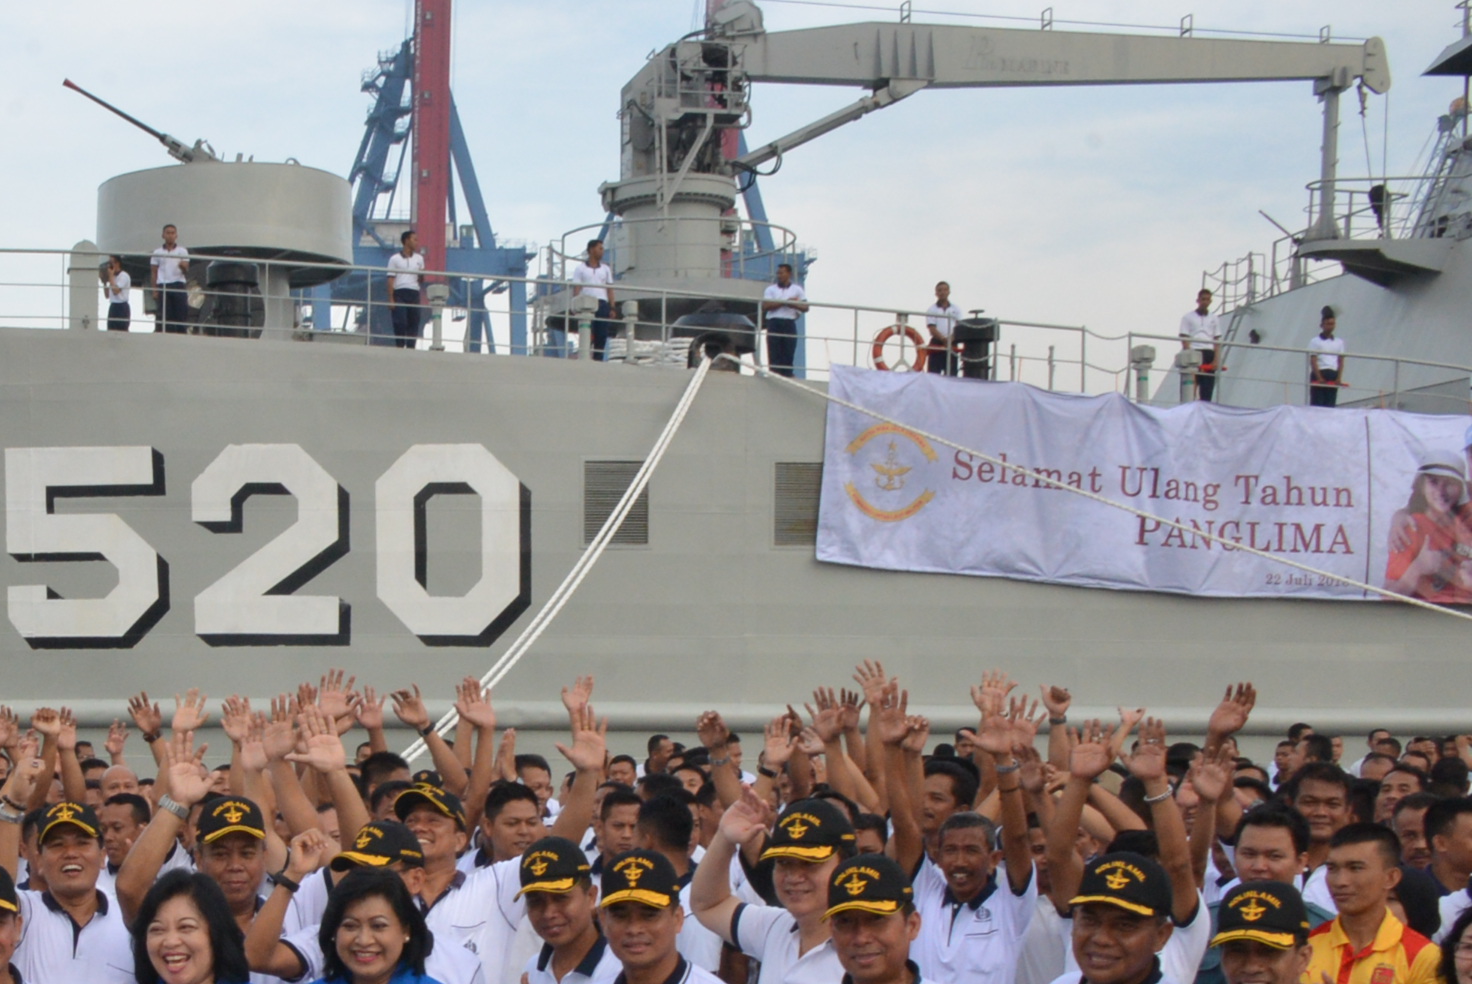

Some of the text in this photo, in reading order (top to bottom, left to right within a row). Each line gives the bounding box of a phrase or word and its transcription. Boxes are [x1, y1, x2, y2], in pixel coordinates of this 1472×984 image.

[952, 449, 1355, 511] Selamat Ulang Tahun
[5, 443, 531, 648] 520
[1134, 514, 1355, 555] PANGLIMA
[1265, 573, 1282, 585] 22
[1285, 573, 1313, 586] Juli
